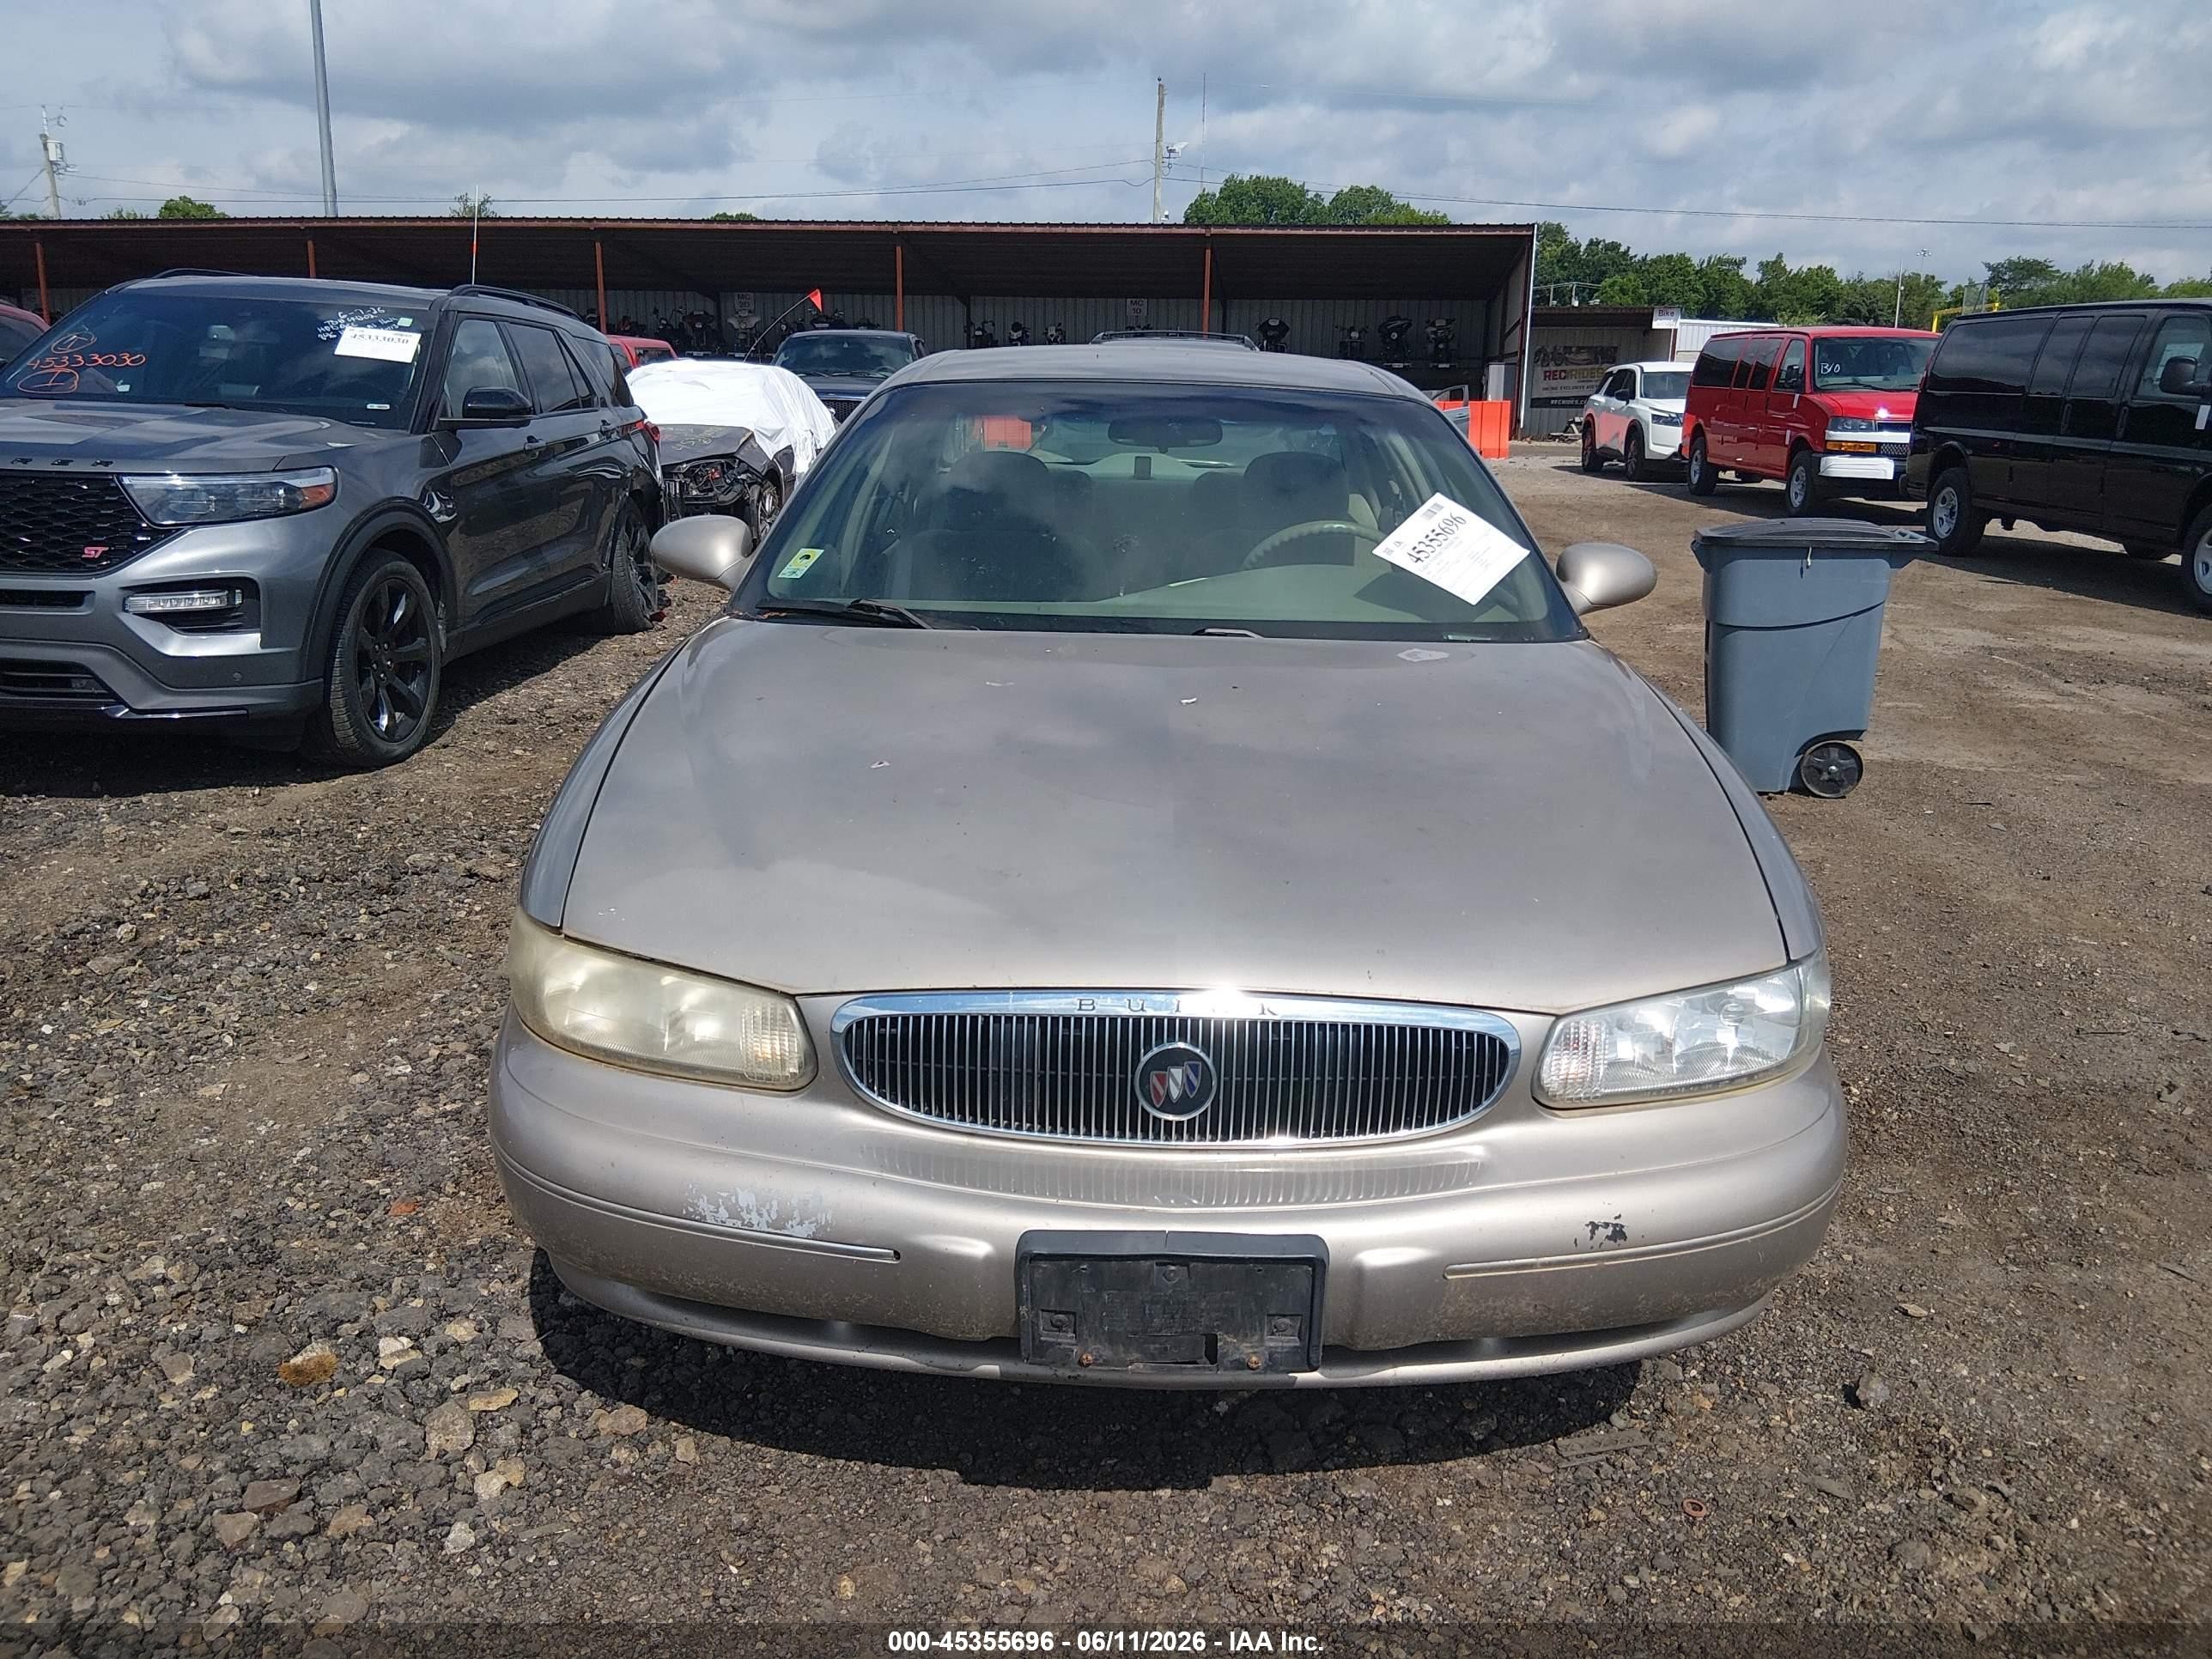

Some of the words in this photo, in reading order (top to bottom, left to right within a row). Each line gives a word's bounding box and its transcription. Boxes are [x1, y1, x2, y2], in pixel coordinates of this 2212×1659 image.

[27, 352, 147, 370] 45333030
[1543, 369, 1567, 381] REC
[1406, 512, 1467, 563] 45355696
[82, 546, 110, 558] ST
